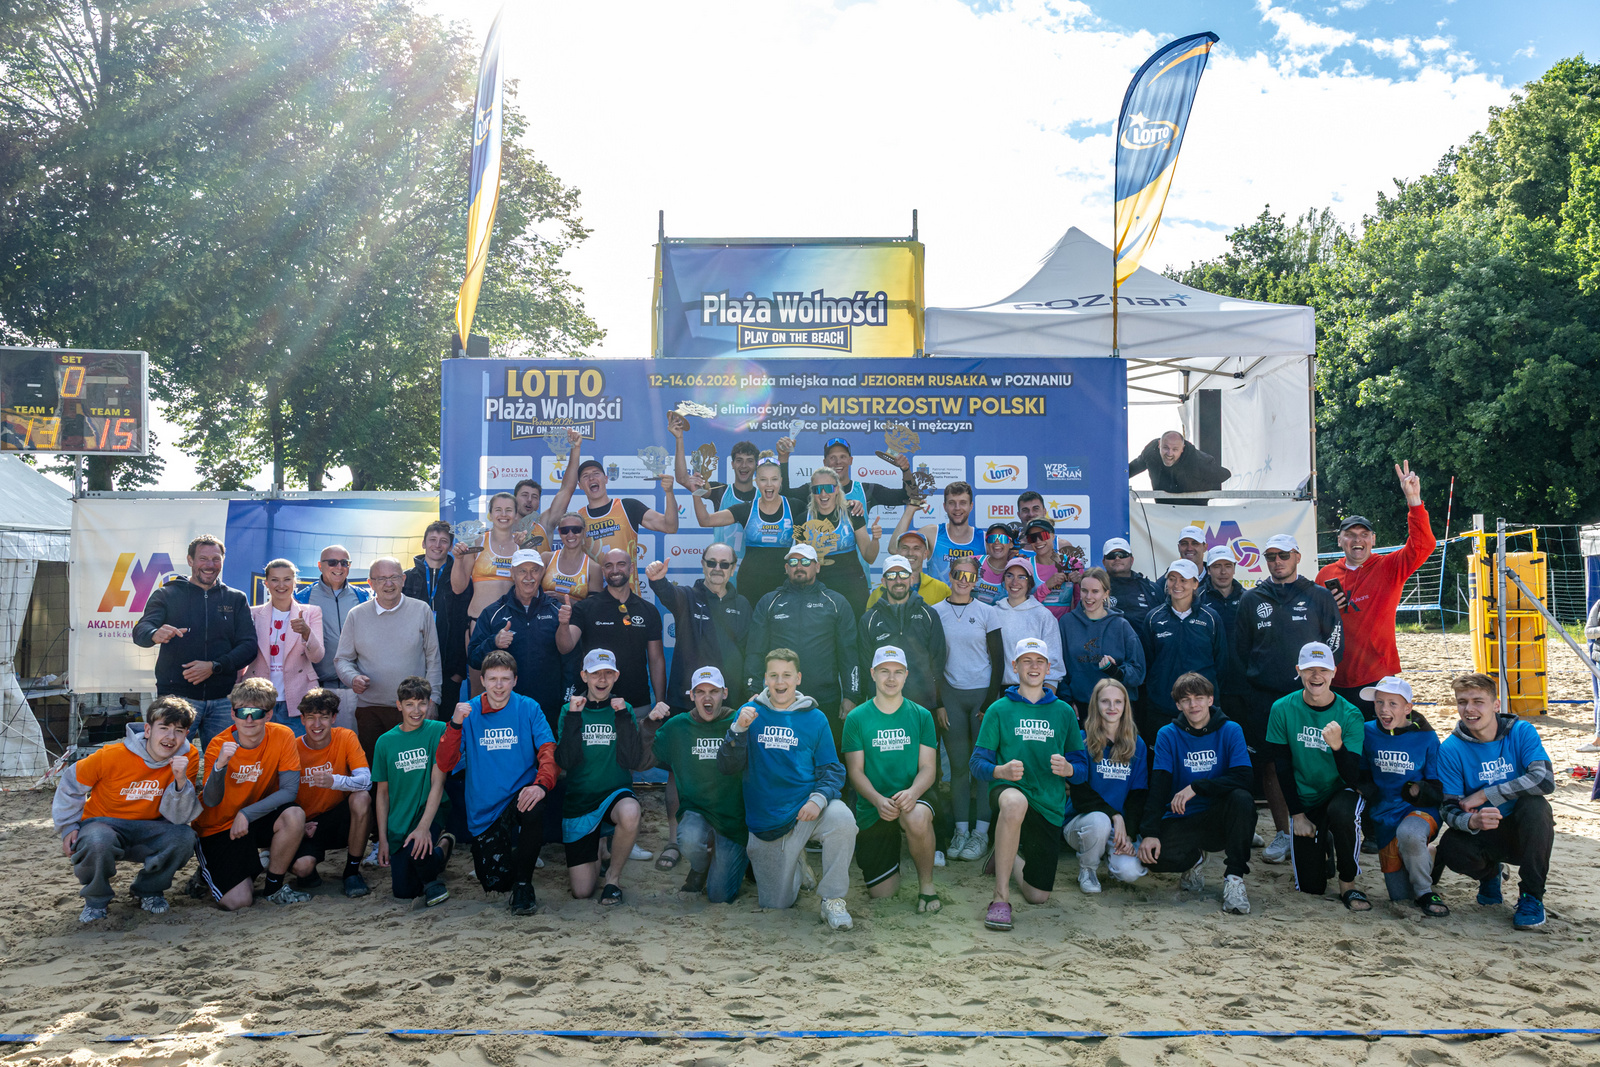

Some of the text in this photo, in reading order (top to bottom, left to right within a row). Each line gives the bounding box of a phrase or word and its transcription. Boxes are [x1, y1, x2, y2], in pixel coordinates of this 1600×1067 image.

[1133, 126, 1170, 144] LOTTO
[703, 294, 884, 323] Plaża Wolności
[744, 331, 844, 345] PLAY ON THE BEACH
[61, 366, 85, 397] 0
[507, 369, 602, 397] LOTTO
[650, 375, 1072, 388] 12-14.06.2026 plaża miejska nad JEZIOREM RUSAŁKA w POZNANIU
[14, 406, 45, 414] TEAM
[486, 398, 621, 420] Plaża Wolności
[720, 403, 797, 416] eliminacyjny
[800, 403, 815, 413] do
[821, 397, 963, 414] MISTRZOSTW
[969, 397, 1044, 414] POLSKI
[90, 408, 130, 417] TEAM 2
[554, 417, 574, 426] 2026
[761, 420, 818, 430] siatkce
[821, 420, 871, 432] plażowej
[918, 420, 972, 432] mężczyzn
[100, 418, 134, 449] 15
[516, 425, 534, 435] PLAY
[536, 426, 547, 434] ON
[1044, 463, 1067, 471] WZPS
[990, 467, 1013, 480] LOTTO
[1046, 469, 1082, 478] POZNAŃ
[991, 505, 1014, 515] PERI
[1052, 507, 1075, 519] LOTTO
[590, 519, 615, 531] LOTTO
[949, 549, 974, 557] LOTTO
[1257, 621, 1271, 629] plus
[587, 725, 611, 734] LOTTO
[1020, 720, 1049, 729] LOTTO
[485, 729, 512, 738] LOTTO
[765, 727, 793, 737] LOTTO
[878, 729, 904, 739] LOTTO
[697, 738, 724, 748] LOTTO
[399, 748, 426, 761] LOTTO
[1188, 751, 1216, 761] LOTTO
[1379, 751, 1409, 761] LOTTO
[1389, 760, 1414, 770] Wolności
[130, 780, 158, 789] LOTTO
